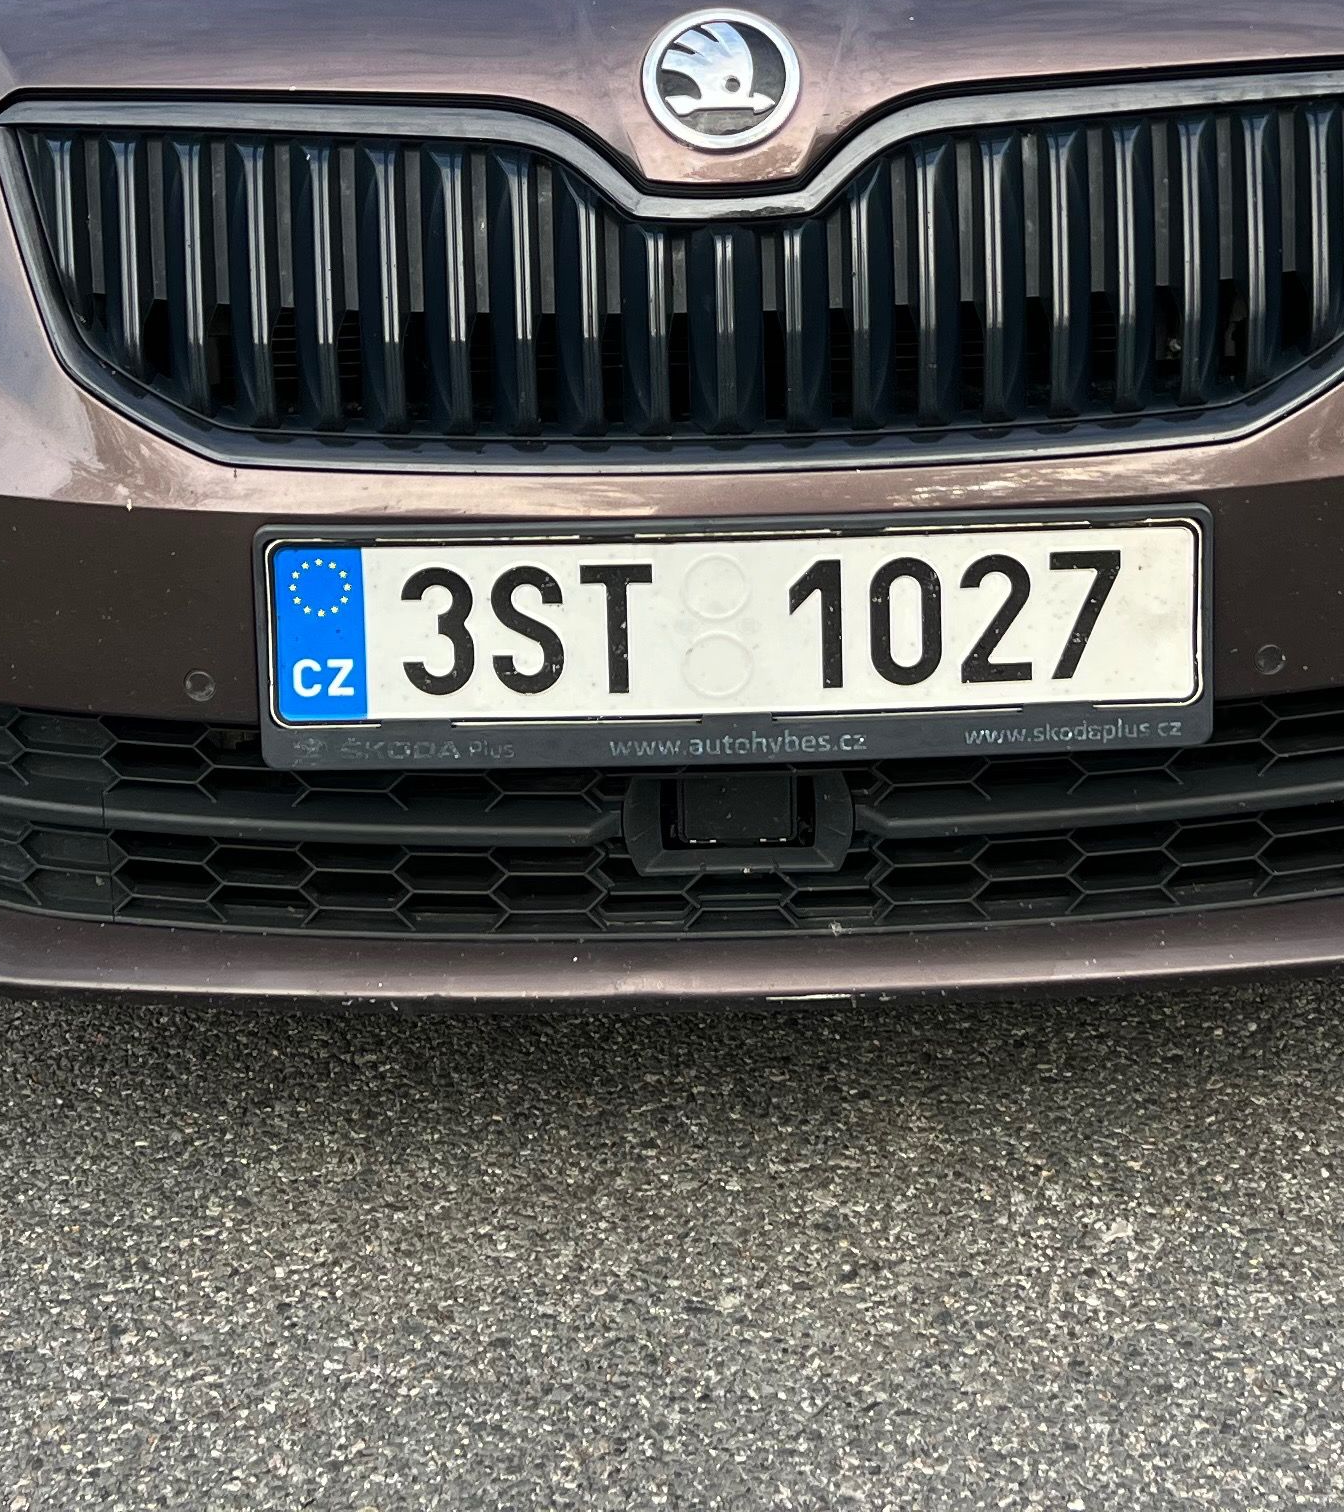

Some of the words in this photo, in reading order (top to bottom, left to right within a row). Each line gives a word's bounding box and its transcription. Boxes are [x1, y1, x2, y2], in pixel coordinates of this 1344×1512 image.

[400, 562, 653, 696] 3ST
[788, 549, 1122, 689] 1027
[292, 658, 355, 697] CZ
[608, 730, 868, 760] www.autohybes.cz
[964, 718, 1183, 745] www.skodapluscz
